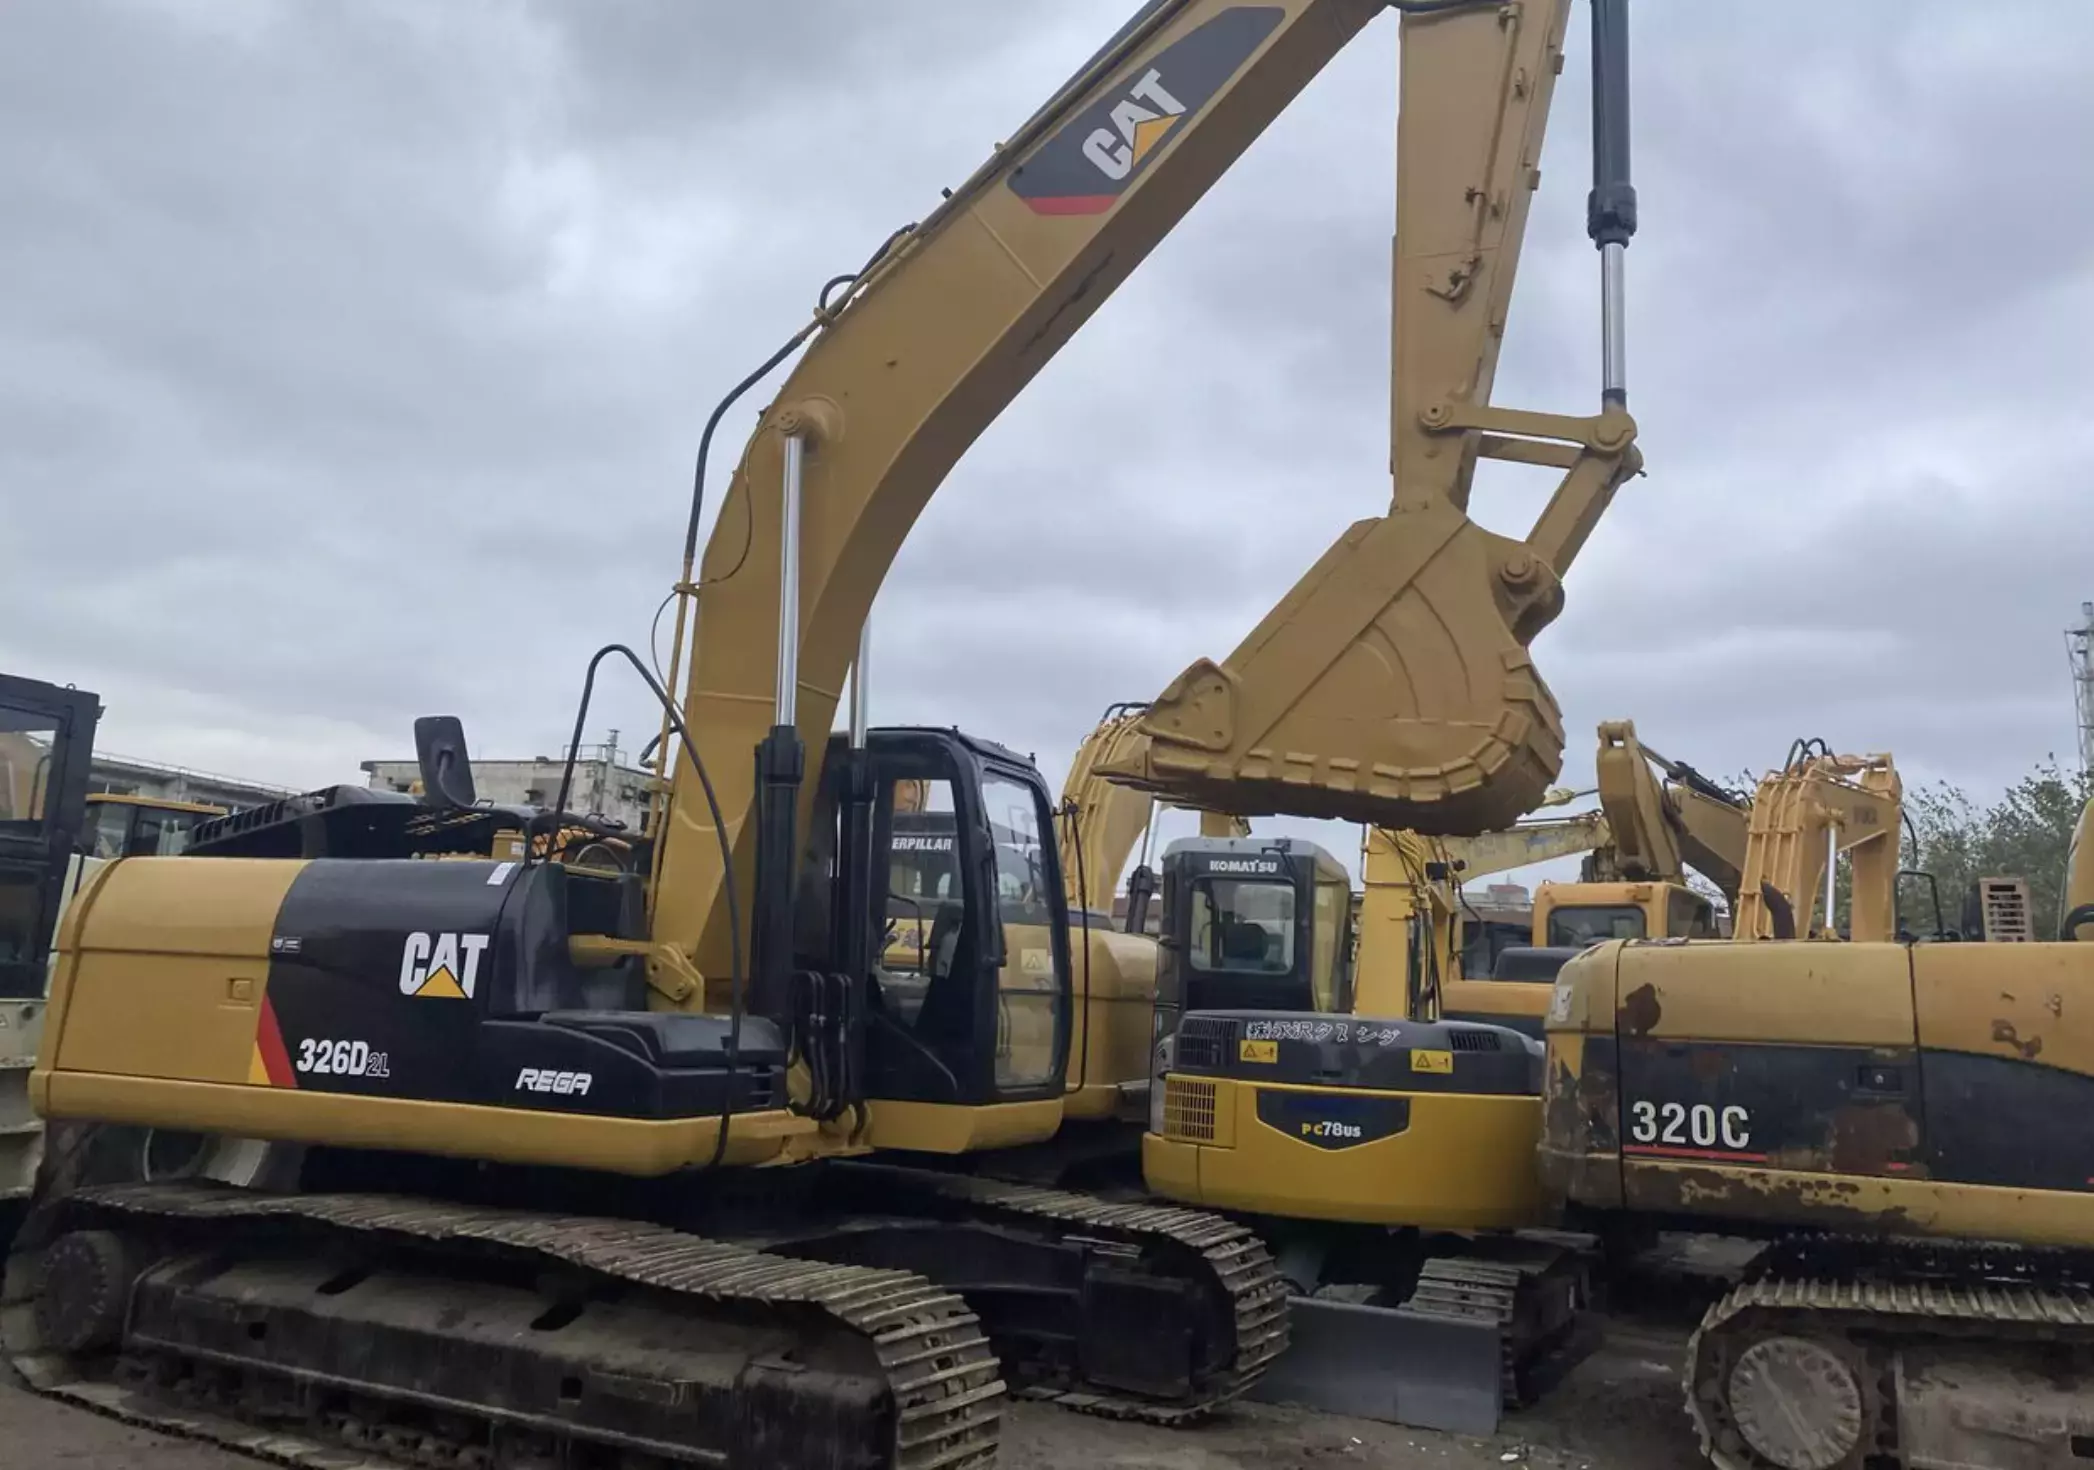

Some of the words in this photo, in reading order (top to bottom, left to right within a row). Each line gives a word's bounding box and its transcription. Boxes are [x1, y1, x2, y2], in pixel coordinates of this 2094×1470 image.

[1082, 68, 1186, 180] CAT
[1209, 860, 1278, 873] KOMATSU
[399, 931, 490, 999] CAT
[515, 1068, 592, 1095] REGA
[1632, 1101, 1750, 1149] 320C
